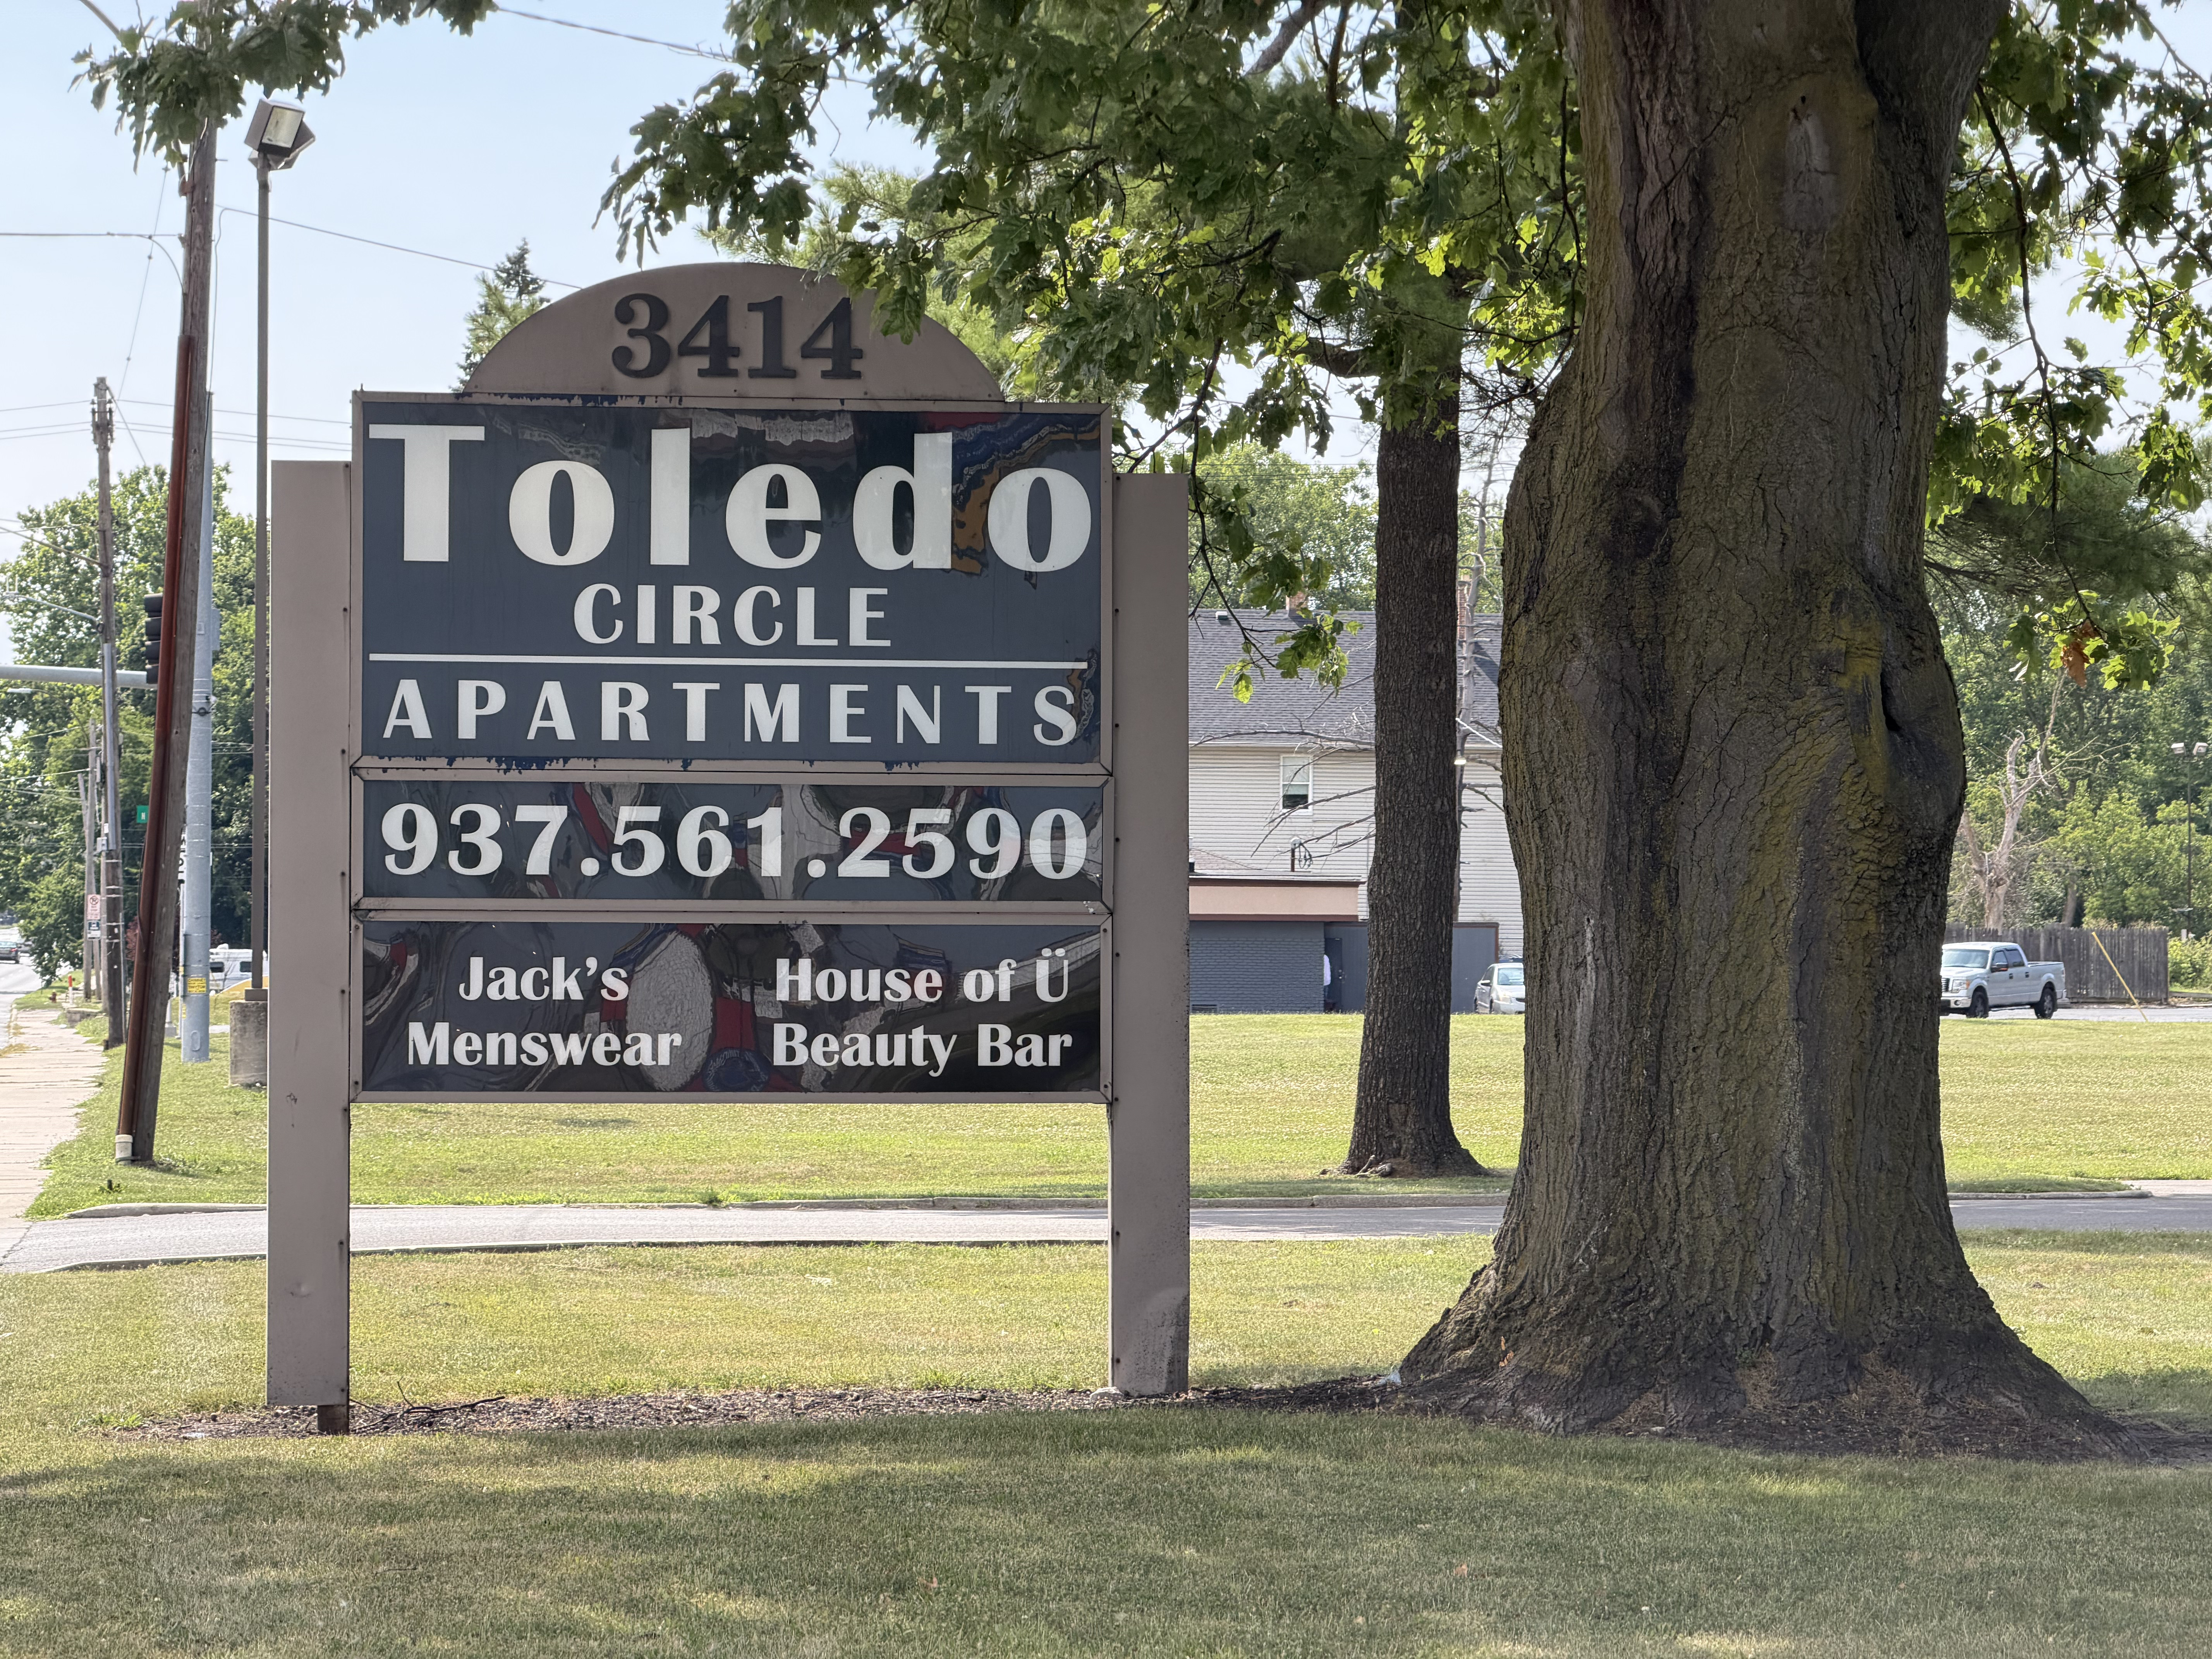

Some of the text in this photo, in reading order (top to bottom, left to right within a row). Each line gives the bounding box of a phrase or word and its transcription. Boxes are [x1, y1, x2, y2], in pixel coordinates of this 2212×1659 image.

[611, 293, 863, 380] 3414
[369, 425, 1091, 572] Toledo
[574, 583, 891, 646] CIRCLE
[383, 679, 1077, 746] APARTMENTS
[382, 803, 1087, 879] 937.561.2590
[459, 957, 629, 1001] Jack's
[776, 948, 1069, 1003] House of Ü
[408, 1022, 682, 1066] Menswear
[773, 1023, 957, 1077] Beauty
[977, 1024, 1072, 1067] Bar
